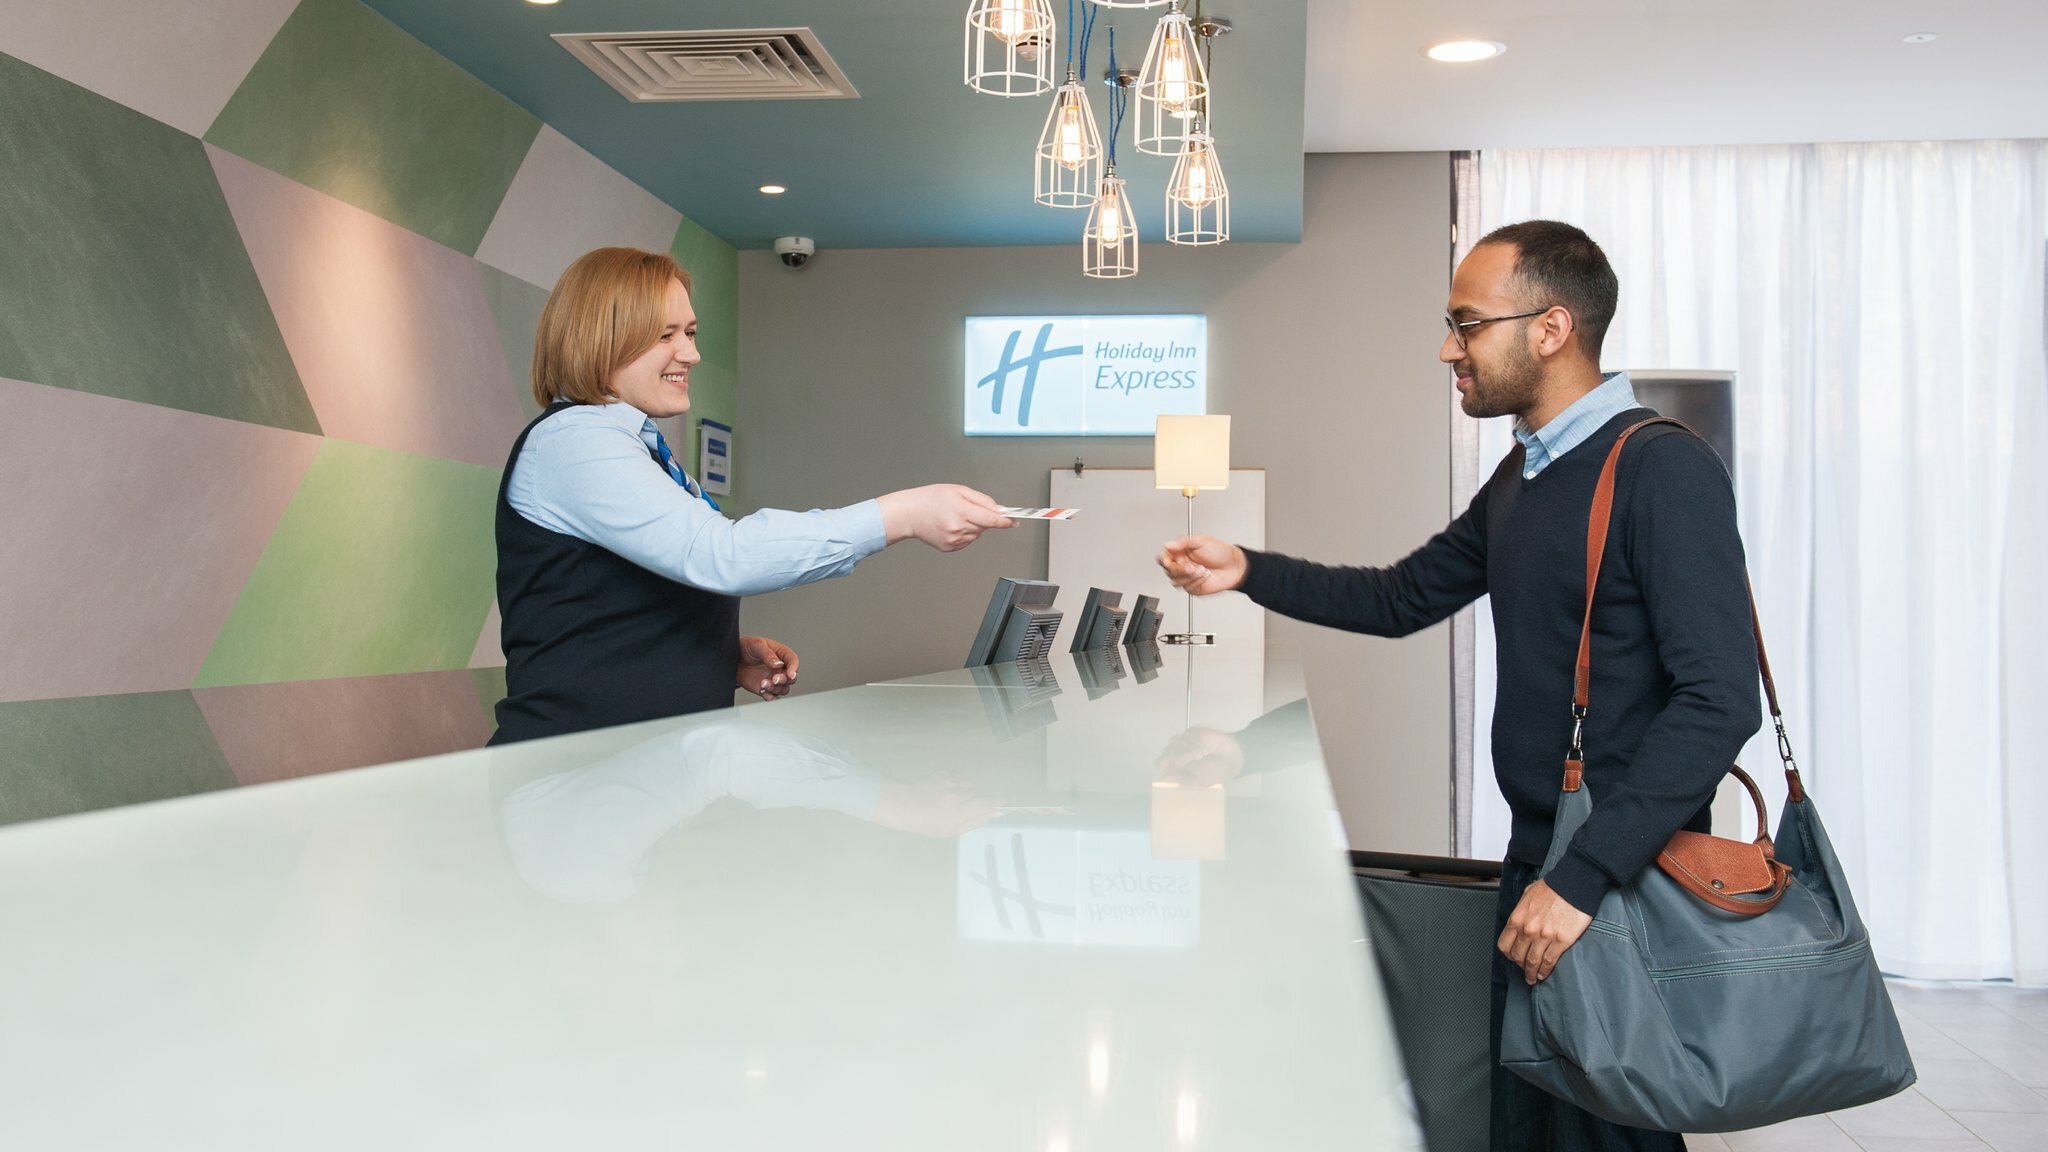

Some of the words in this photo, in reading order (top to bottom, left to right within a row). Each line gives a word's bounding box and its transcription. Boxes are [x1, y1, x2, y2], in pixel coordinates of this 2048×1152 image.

[1095, 341, 1165, 362] Holiday
[1168, 341, 1197, 359] Inn
[1095, 365, 1197, 396] Express
